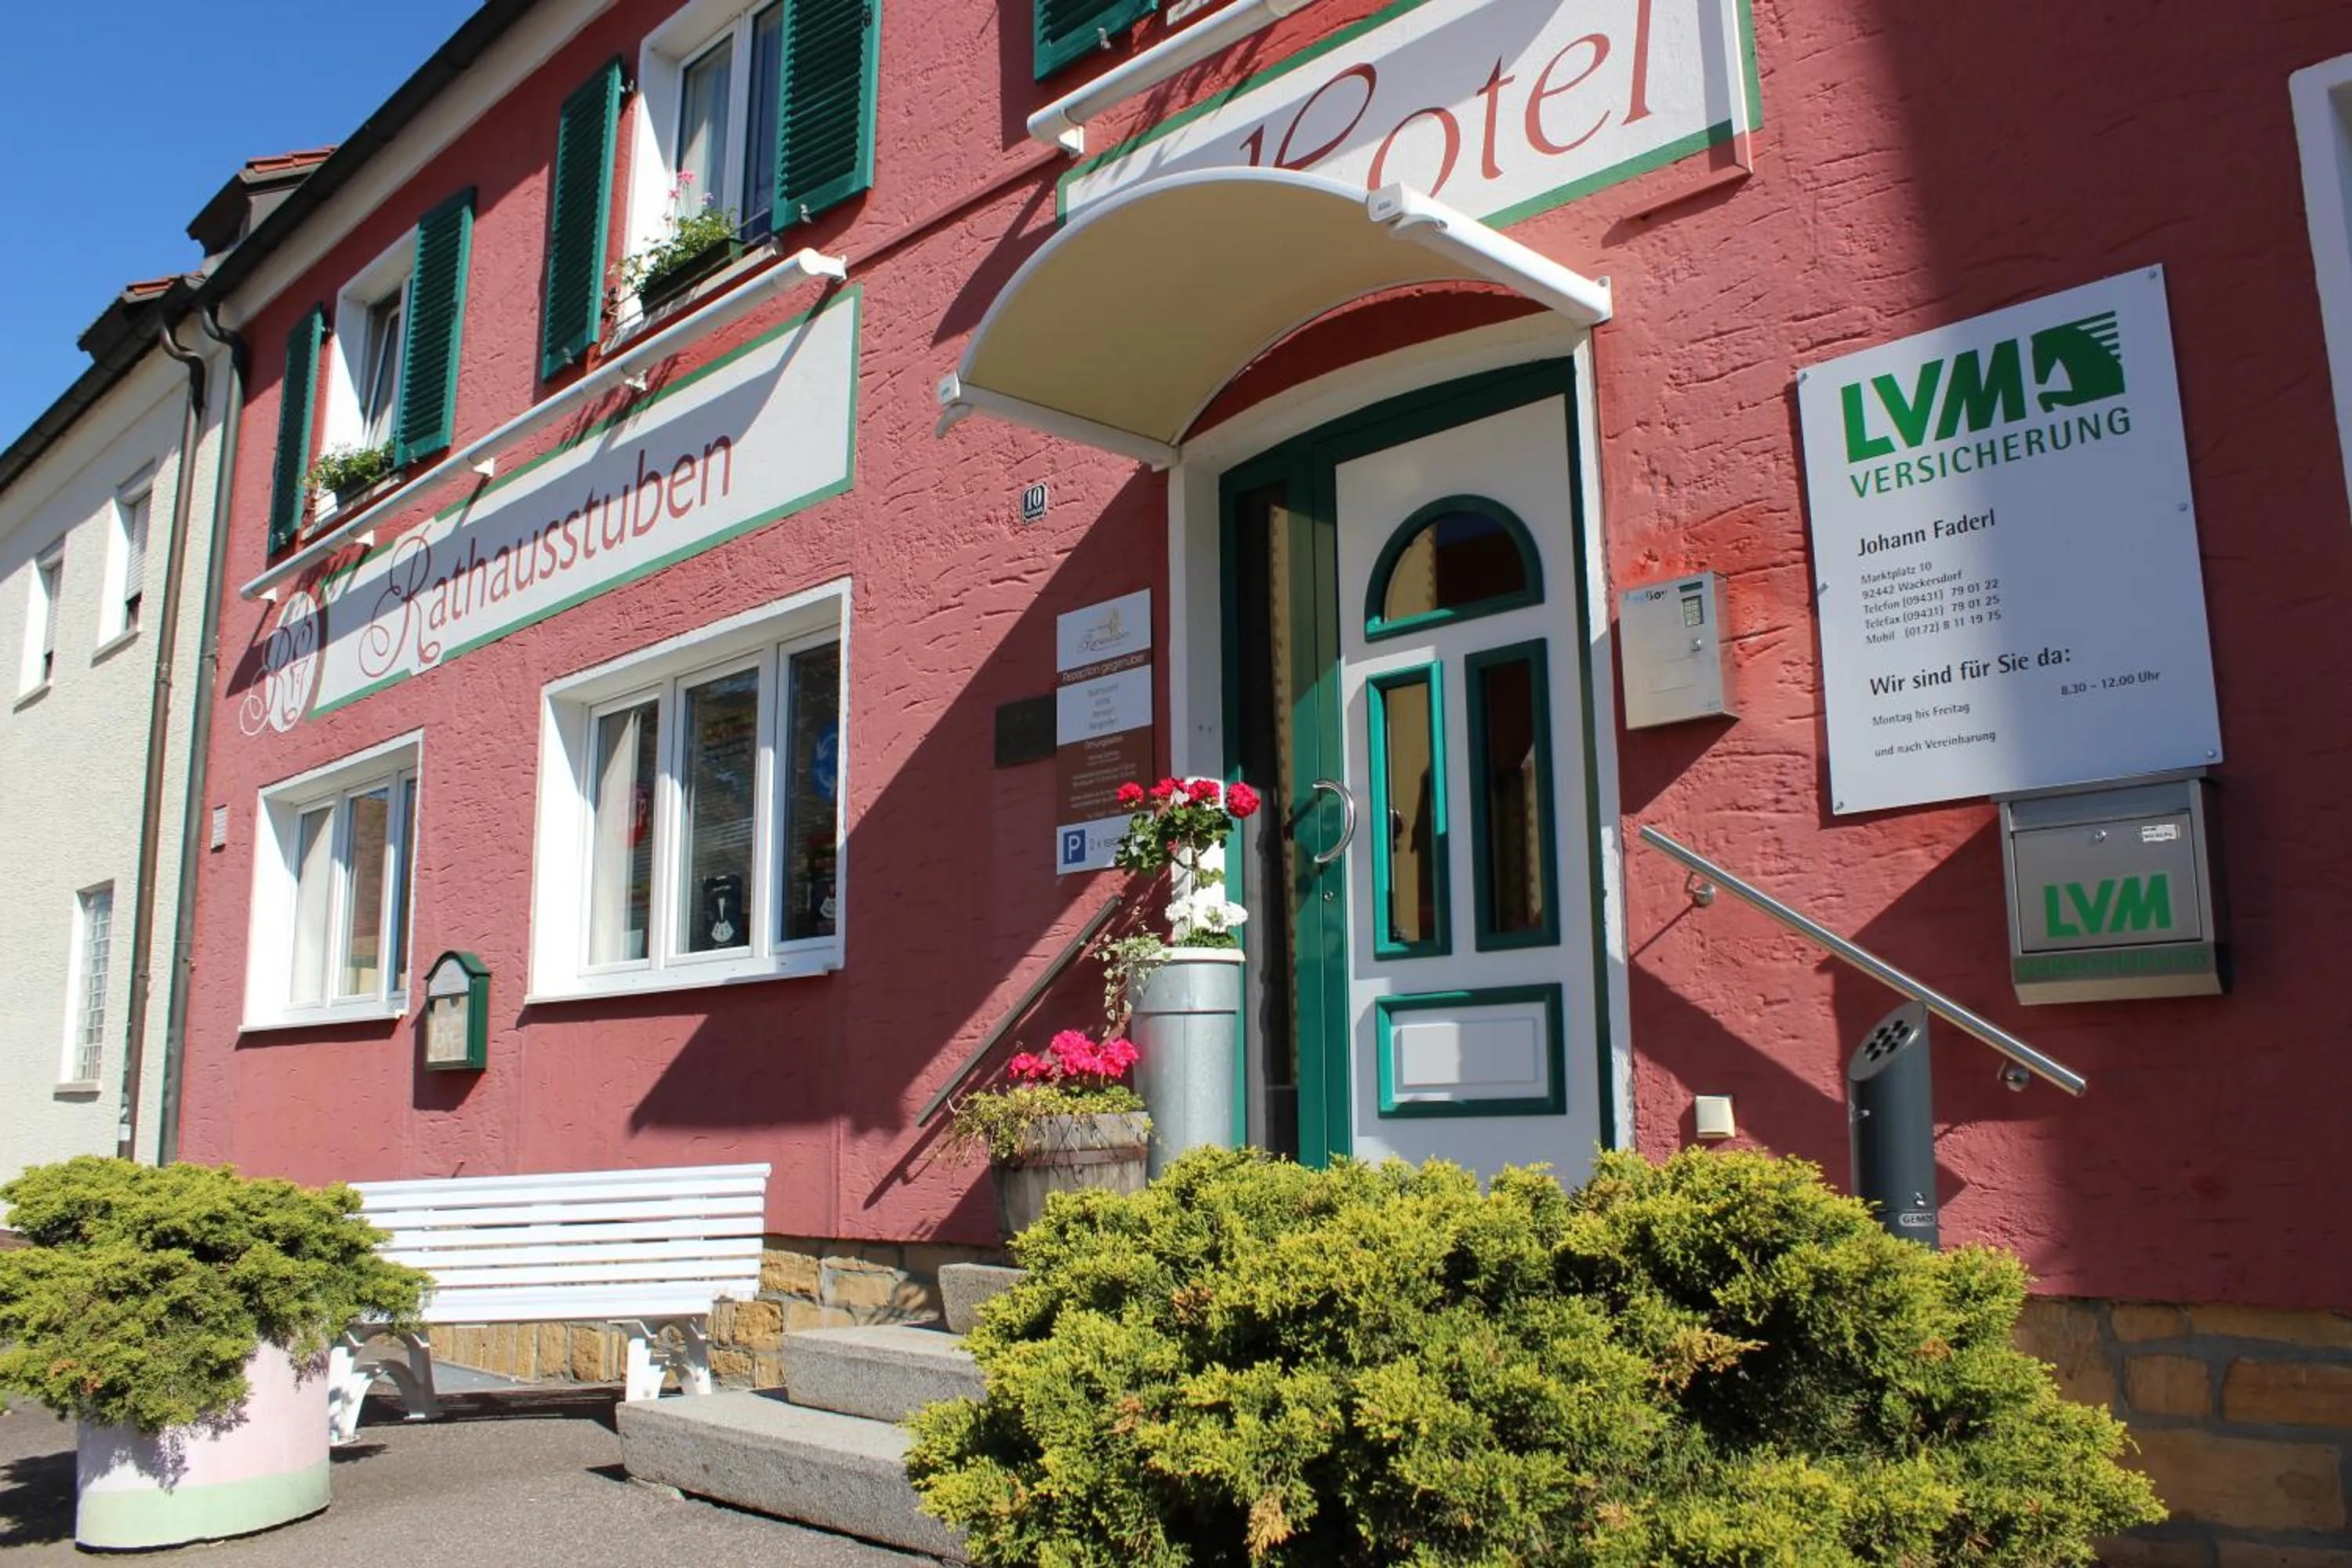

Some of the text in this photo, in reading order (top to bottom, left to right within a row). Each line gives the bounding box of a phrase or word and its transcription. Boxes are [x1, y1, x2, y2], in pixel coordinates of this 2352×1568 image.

[1840, 338, 2027, 464] LVM
[1849, 406, 2132, 499] VERSICHERUNG
[1026, 486, 1043, 510] 10
[1857, 507, 1996, 557] Johann Faderl
[358, 433, 733, 678] Rathausstuben
[1860, 561, 1933, 585] Marktplatz 10
[1861, 570, 1963, 600] 92442 Wackersdorf
[1864, 578, 1999, 615] Telefon (09431) 79 01 22
[1864, 594, 2000, 630] Telefax (09431) 79 01 25
[1865, 630, 1896, 645] Mobil
[1904, 621, 1940, 639] (0172)
[1955, 617, 1965, 628] 11
[1970, 613, 1984, 625] 19
[1987, 609, 2002, 622] 75
[1870, 646, 2071, 696] Wir sind für Sie da:
[2101, 673, 2135, 691] 12.00
[2138, 670, 2161, 683] Uhr
[1871, 702, 1970, 727] Montag bis Freitag
[1875, 729, 1996, 757] und nach Vereinbarung
[2042, 873, 2172, 938] LVM
